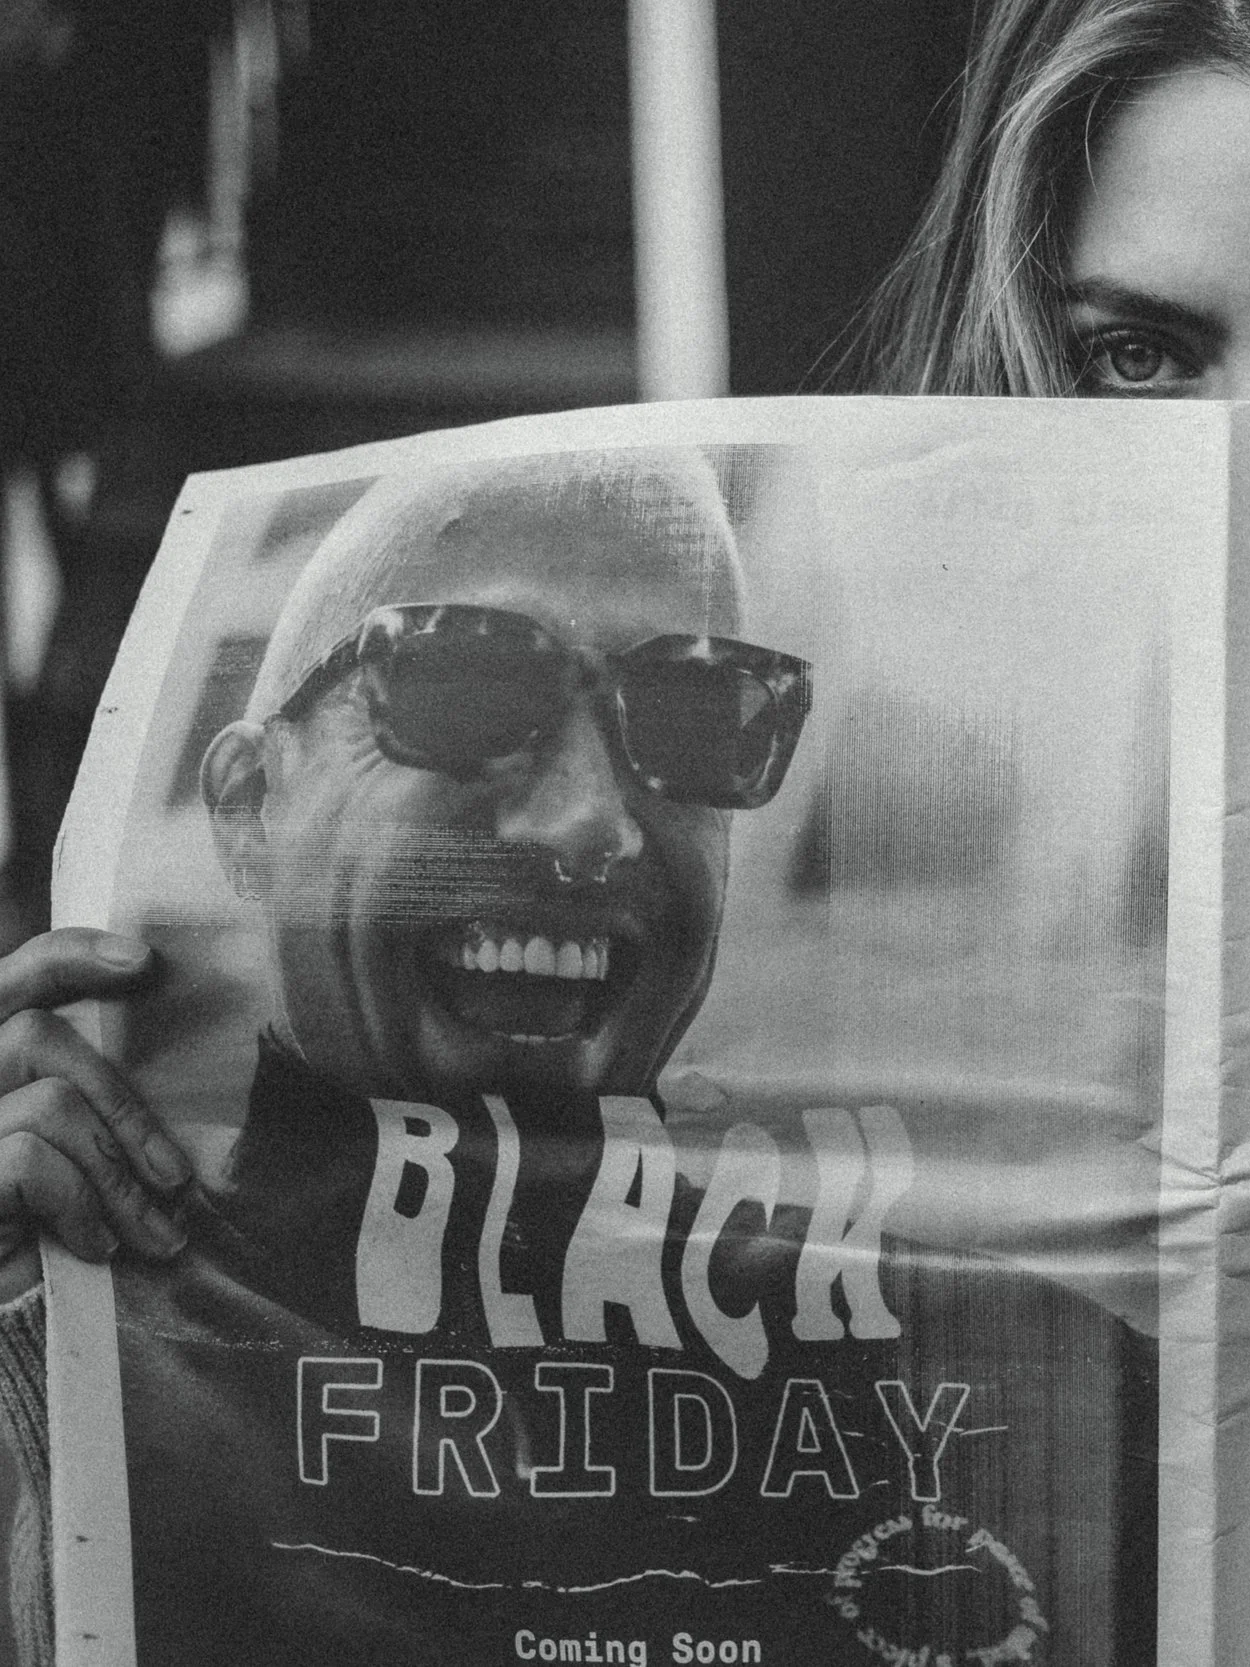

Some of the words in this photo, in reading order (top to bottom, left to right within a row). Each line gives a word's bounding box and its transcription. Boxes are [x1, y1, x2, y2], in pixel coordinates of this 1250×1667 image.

[355, 1094, 914, 1380] BLACK
[298, 1356, 970, 1502] FRIDAY
[514, 1629, 647, 1667] Coming
[672, 1632, 762, 1664] Soon
